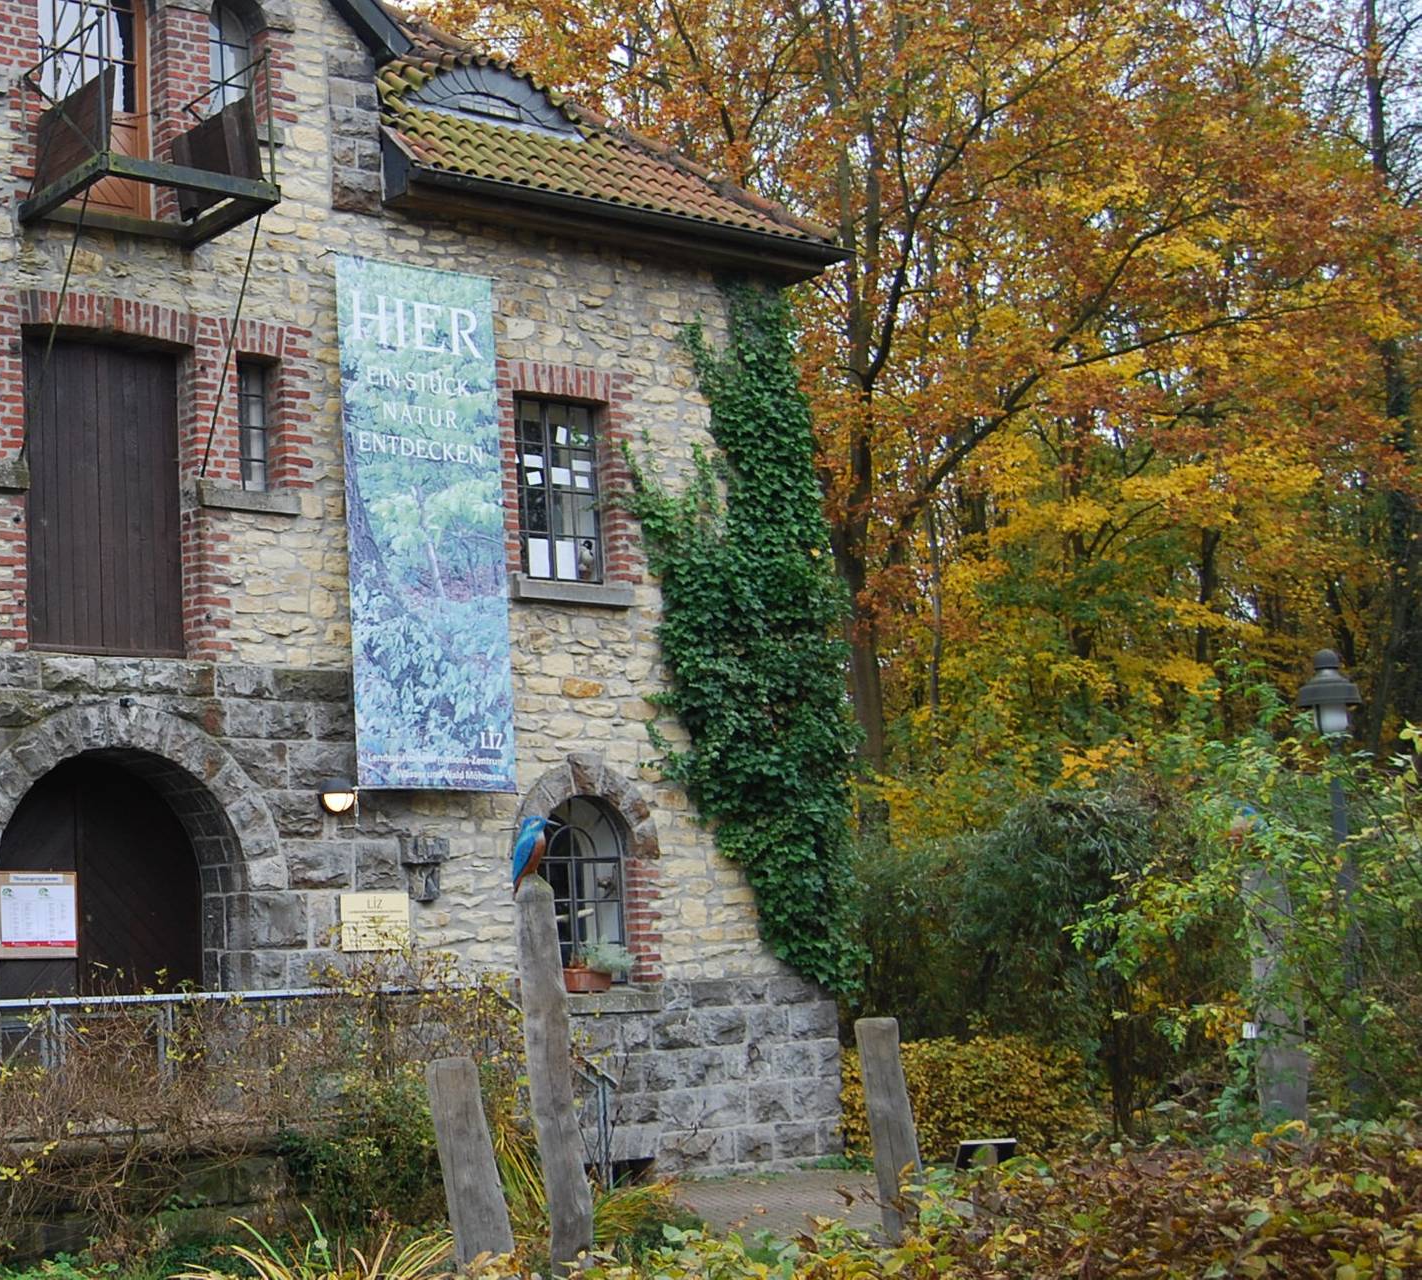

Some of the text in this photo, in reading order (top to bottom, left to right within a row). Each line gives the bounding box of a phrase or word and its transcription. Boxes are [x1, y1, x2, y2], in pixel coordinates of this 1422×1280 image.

[349, 289, 484, 360] HIER
[367, 366, 471, 397] EIN STÜCK
[382, 402, 458, 429] NATUR
[358, 432, 484, 465] ENTDECKEN
[369, 754, 504, 765] Lands-formations-Zentrum
